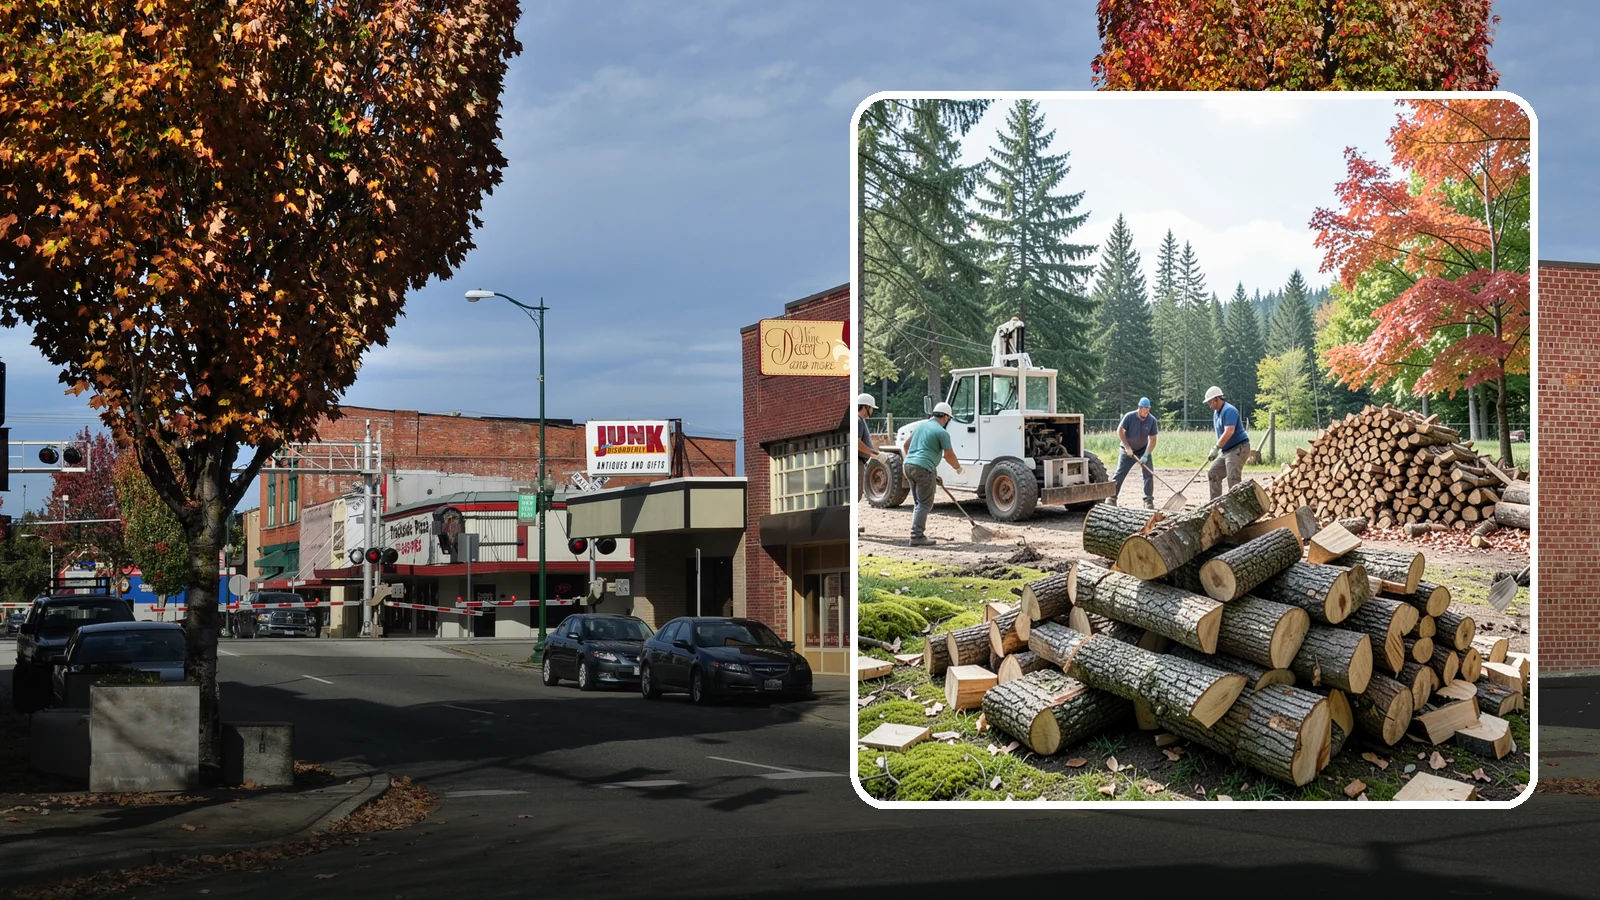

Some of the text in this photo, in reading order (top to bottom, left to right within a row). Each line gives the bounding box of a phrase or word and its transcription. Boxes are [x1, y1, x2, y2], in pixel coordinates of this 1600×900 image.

[596, 425, 665, 457] JUNK
[607, 446, 646, 454] DISORDERLY
[597, 460, 665, 470] ANTIQUES AND GIFTS
[414, 519, 429, 535] Pizza
